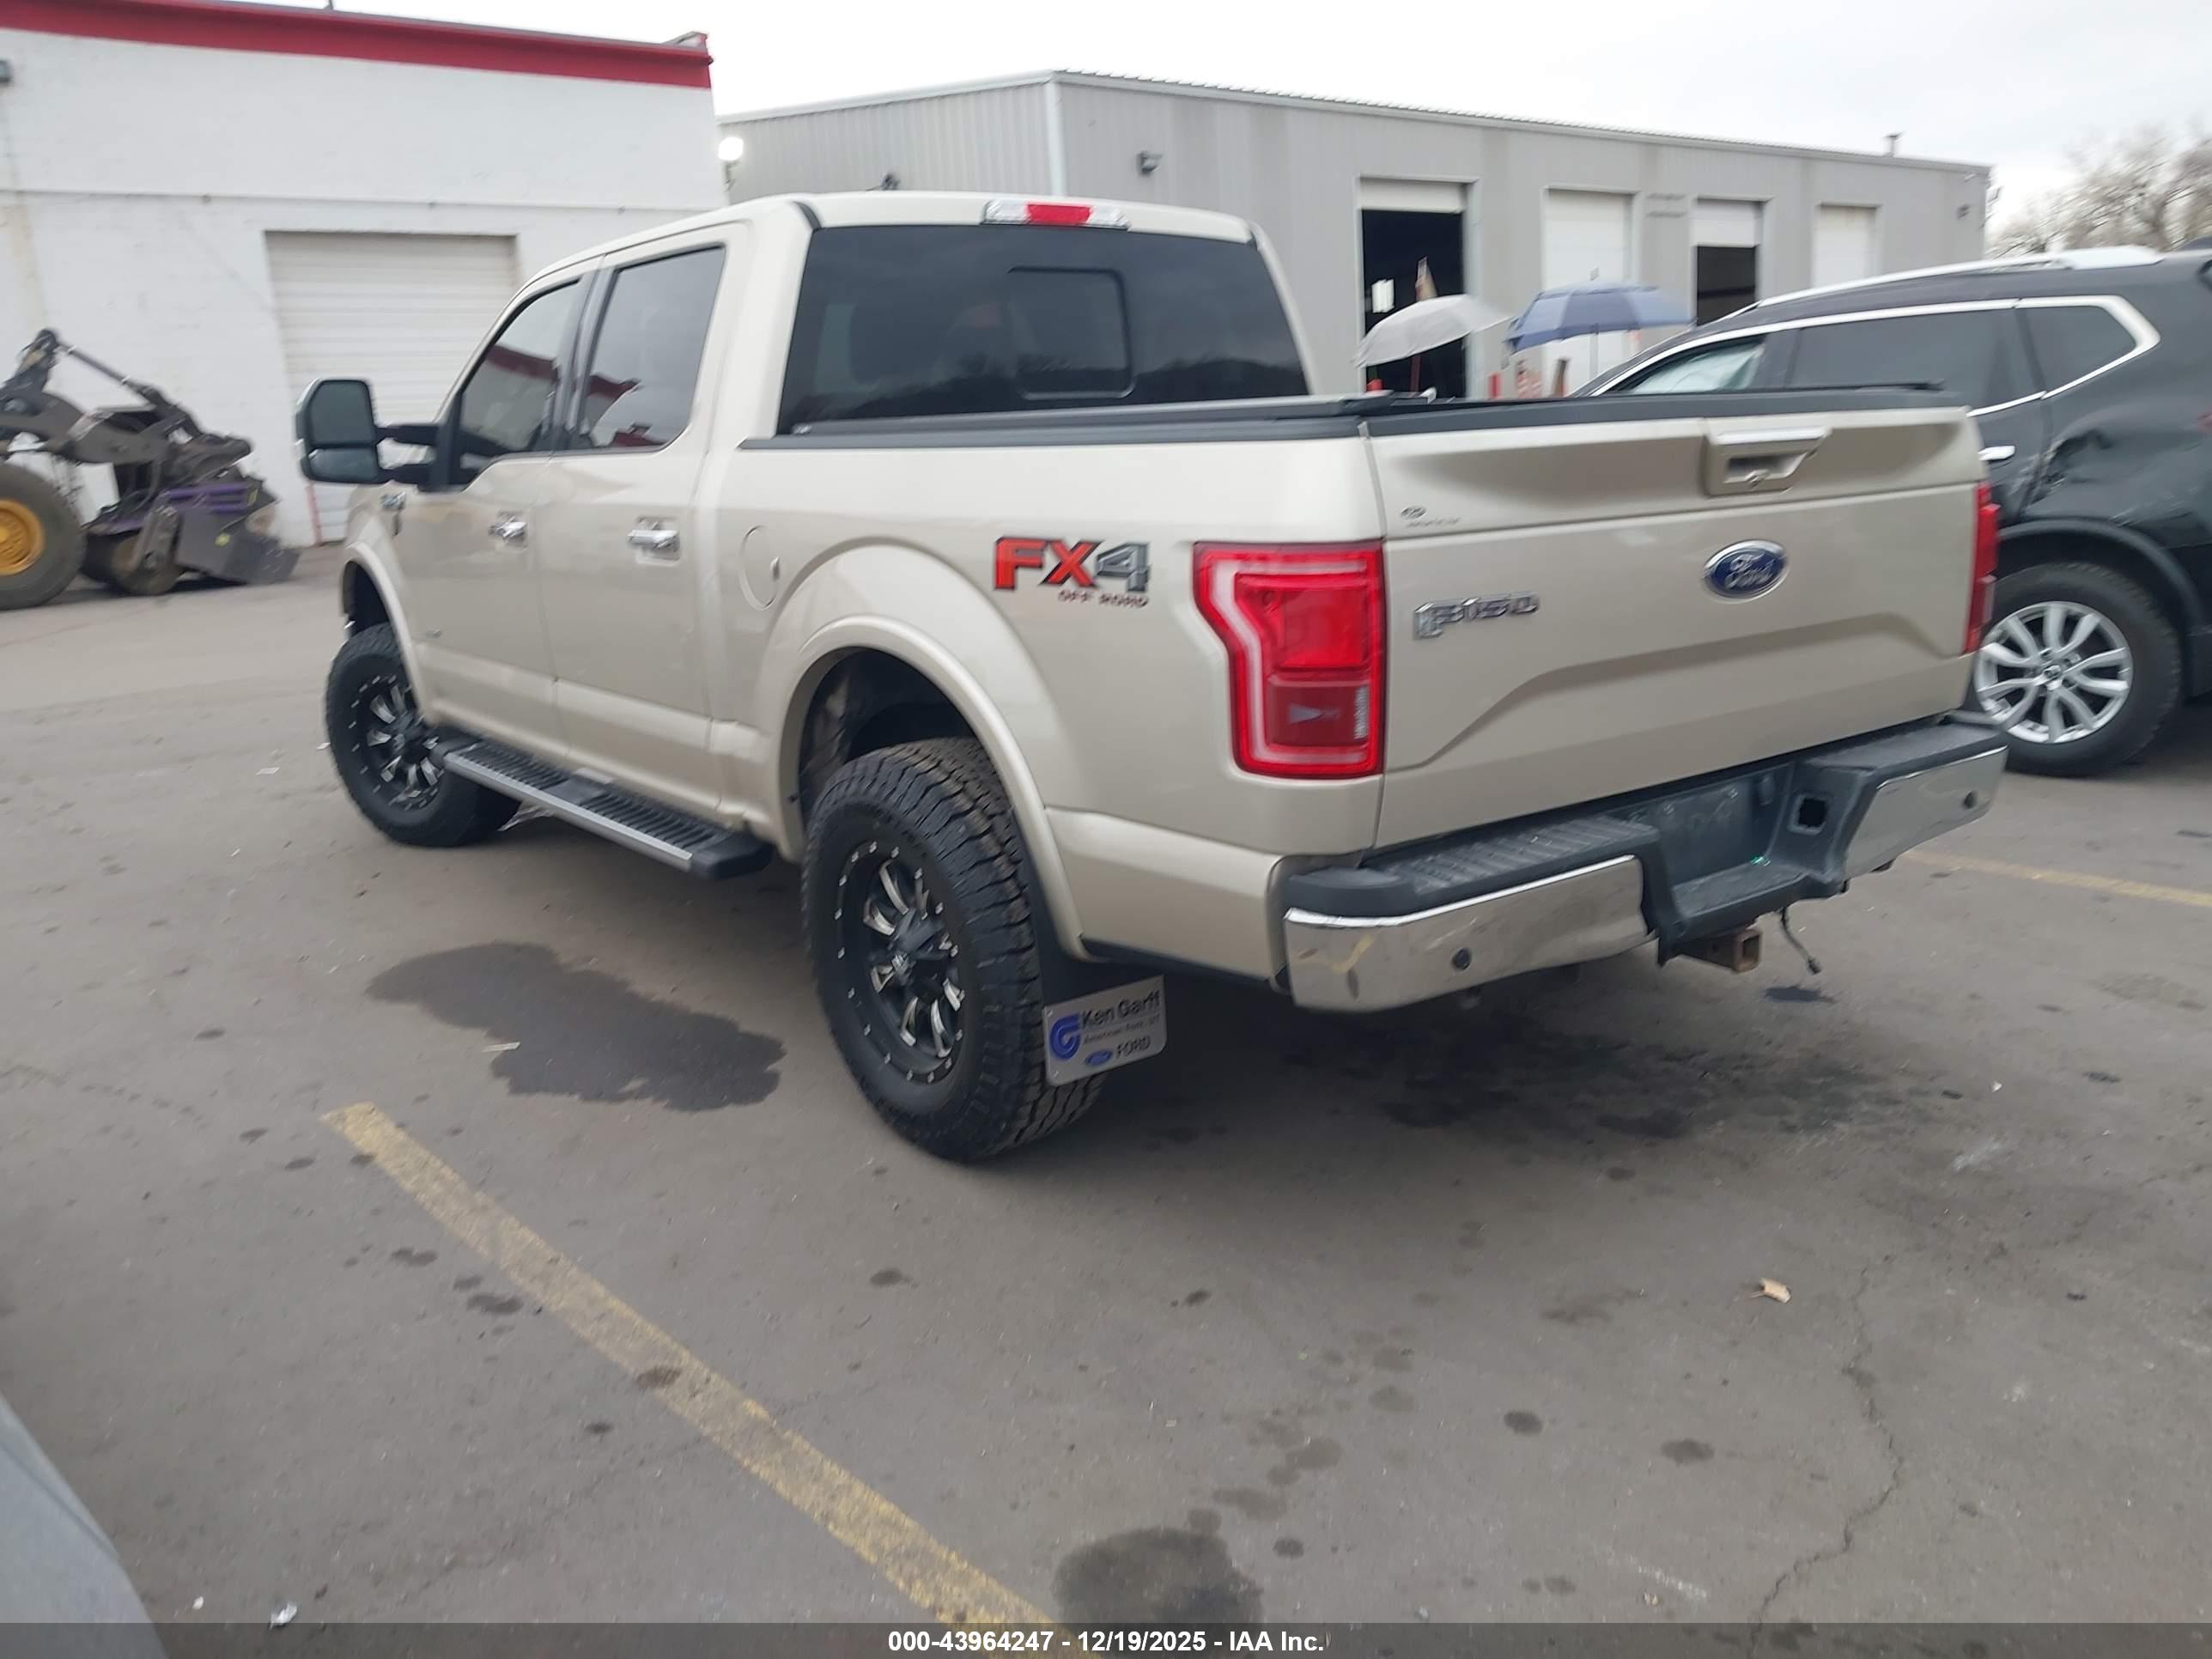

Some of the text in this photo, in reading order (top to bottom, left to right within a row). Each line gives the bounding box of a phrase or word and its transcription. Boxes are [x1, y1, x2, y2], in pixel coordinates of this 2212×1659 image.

[994, 537, 1151, 592] FX4
[1082, 990, 1161, 1030] Ken Garff
[1116, 1035, 1152, 1060] FORD
